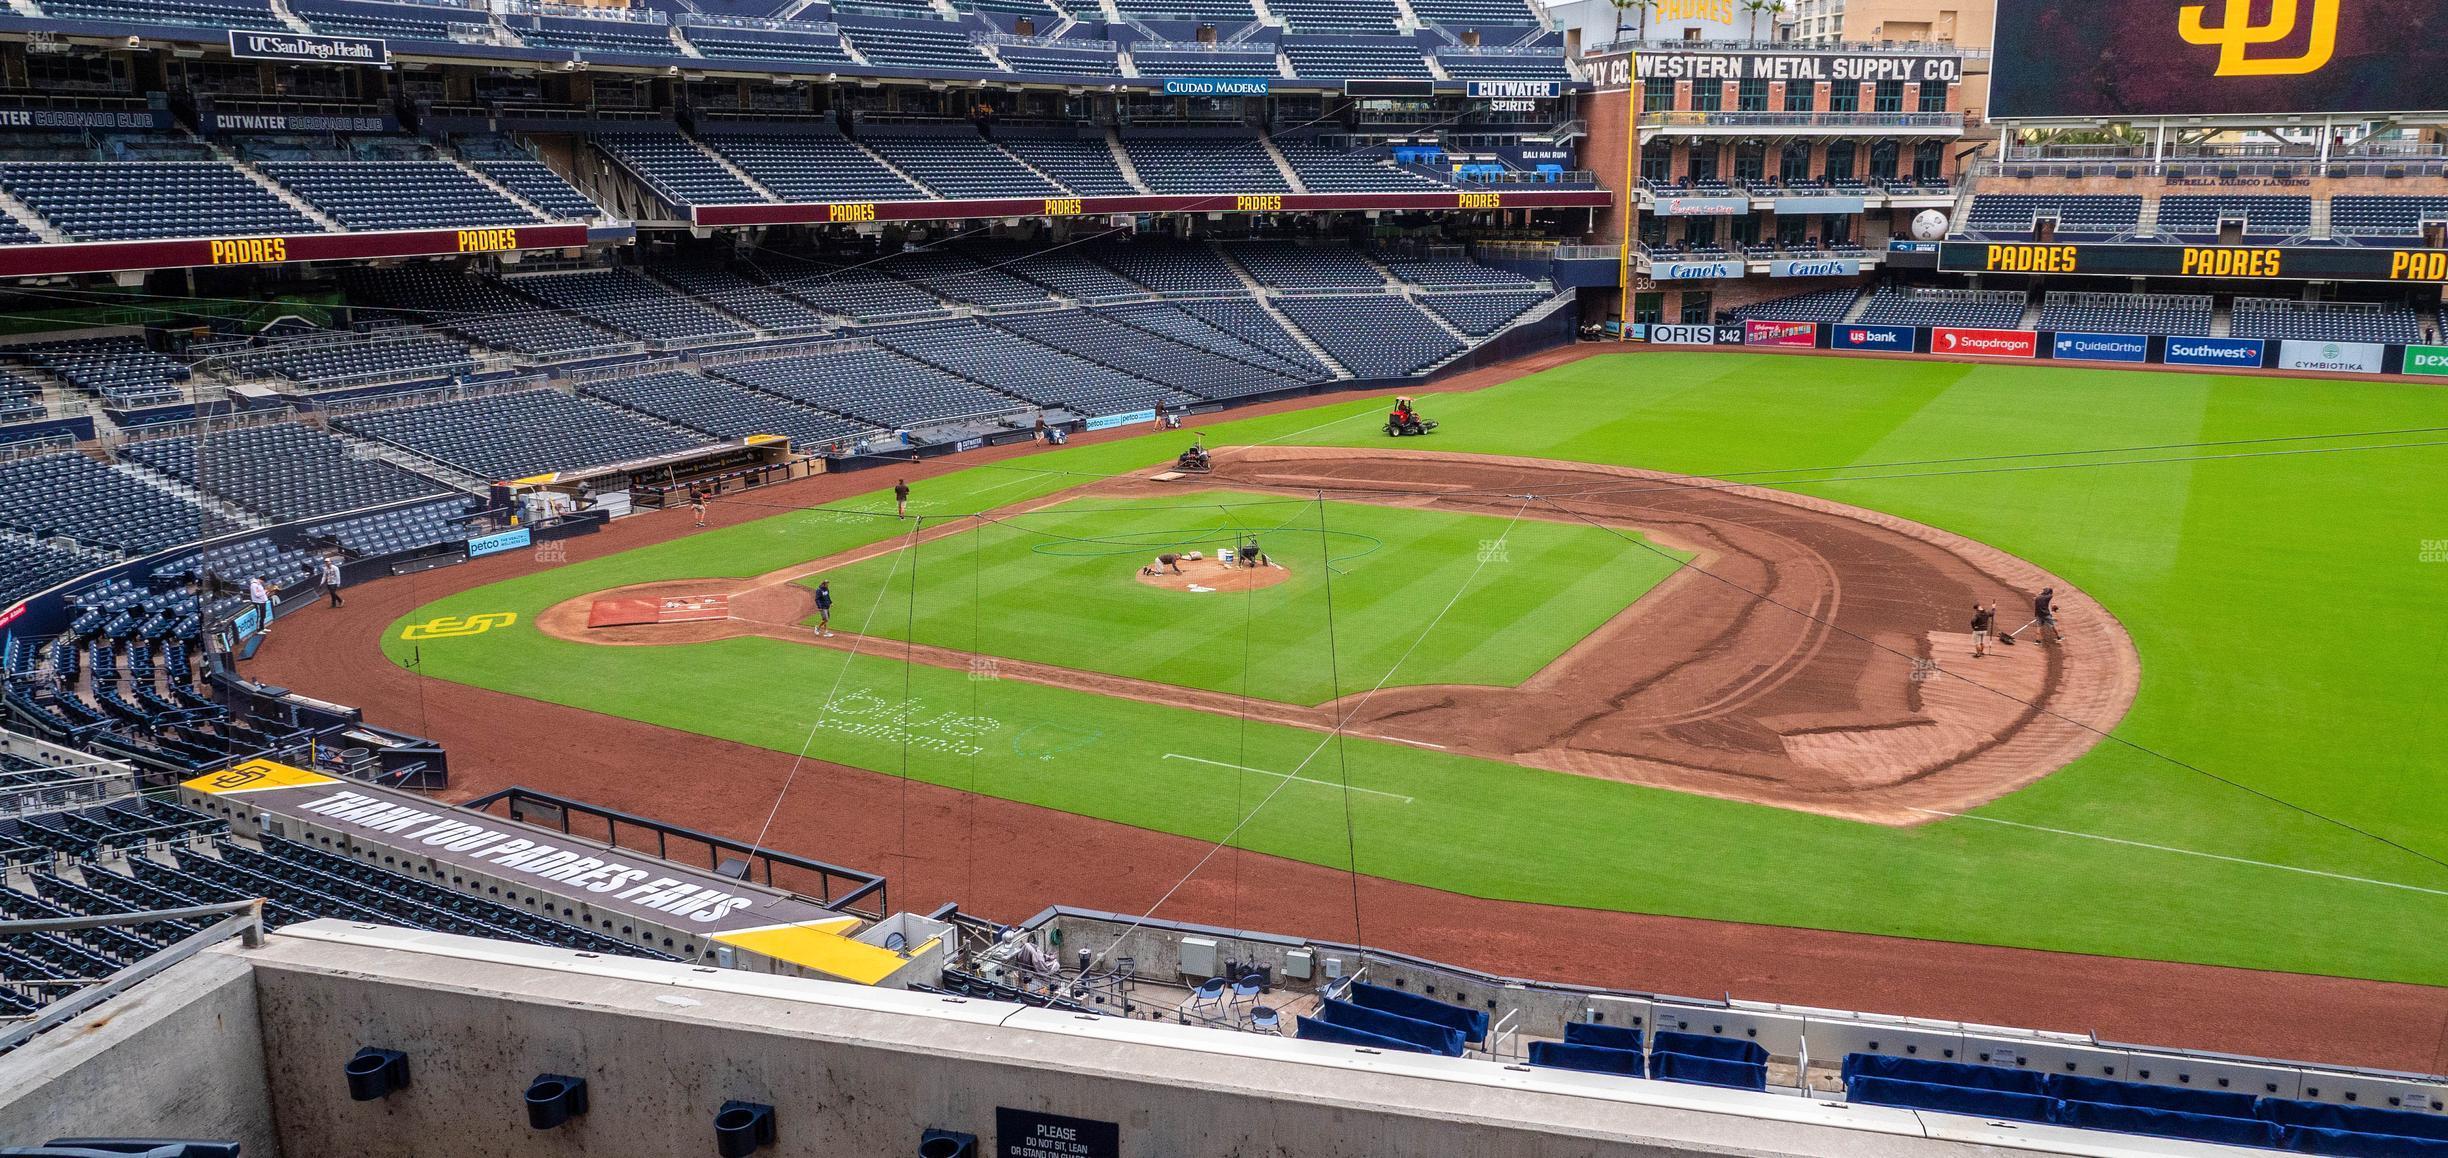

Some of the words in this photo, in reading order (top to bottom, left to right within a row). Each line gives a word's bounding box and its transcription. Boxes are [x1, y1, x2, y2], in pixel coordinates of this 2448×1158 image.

[248, 36, 271, 52] UC
[271, 37, 297, 53] San
[297, 39, 334, 59] Diego
[333, 41, 374, 58] Health
[1611, 59, 1631, 85] CO.
[1635, 55, 1743, 78] WESTERN
[1753, 57, 1826, 79] METAL
[1832, 58, 1916, 80] SUPPLY
[1923, 59, 1959, 81] CO.
[1167, 81, 1213, 93] CIUDAD
[1216, 82, 1266, 93] MADERAS
[1478, 82, 1550, 96] CUTWATER
[1491, 101, 1536, 112] SPIRITS
[0, 111, 31, 125] TER
[34, 111, 116, 127] CORONADO
[117, 113, 154, 128] CLUB
[217, 114, 285, 129] CUTWATER
[288, 117, 352, 131] CORONADO
[353, 118, 384, 131] CLUB
[1522, 151, 1538, 159] BALI
[1552, 151, 1567, 159] RUM
[2166, 178, 2216, 187] ESTRELLA
[2218, 178, 2260, 187] JALISCO
[2262, 178, 2311, 187] LANDING
[1045, 199, 1082, 215] PADRES
[1237, 195, 1282, 210] PADRES
[1459, 193, 1500, 208] PADRES
[829, 203, 875, 222] PADRES
[458, 229, 517, 251] PADRES
[210, 238, 286, 265] PADRES
[1986, 245, 2077, 272] PADRES
[1788, 261, 1844, 277] Canel's
[2181, 248, 2281, 276] PADRES
[2390, 251, 2448, 280] PAD
[1669, 263, 1727, 279] Canel's
[1636, 277, 1656, 289] 330
[1654, 326, 1712, 343] ORIS
[1719, 329, 1741, 342] 342
[1851, 332, 1865, 341] us
[1866, 331, 1897, 342] bank
[1961, 336, 2029, 351] Snapdragon
[2075, 341, 2142, 353] QuidelOrtho
[2171, 344, 2245, 358] Southwest
[2295, 361, 2363, 371] CYMBIOTIKA
[1087, 419, 1104, 428] petco
[1122, 413, 1138, 423] petco
[471, 539, 499, 554] petco
[297, 790, 444, 834] THANK
[401, 818, 511, 853] YOU
[470, 836, 650, 893] PADRES
[613, 876, 753, 922] FANS
[1037, 1124, 1076, 1141] PLEASE
[1010, 1146, 1021, 1156] OR
[1022, 1147, 1046, 1158] STAND
[1026, 1136, 1037, 1147] DO
[1038, 1138, 1053, 1149] NOT
[1054, 1141, 1067, 1152] SIT,
[1068, 1143, 1088, 1154] LEAN
